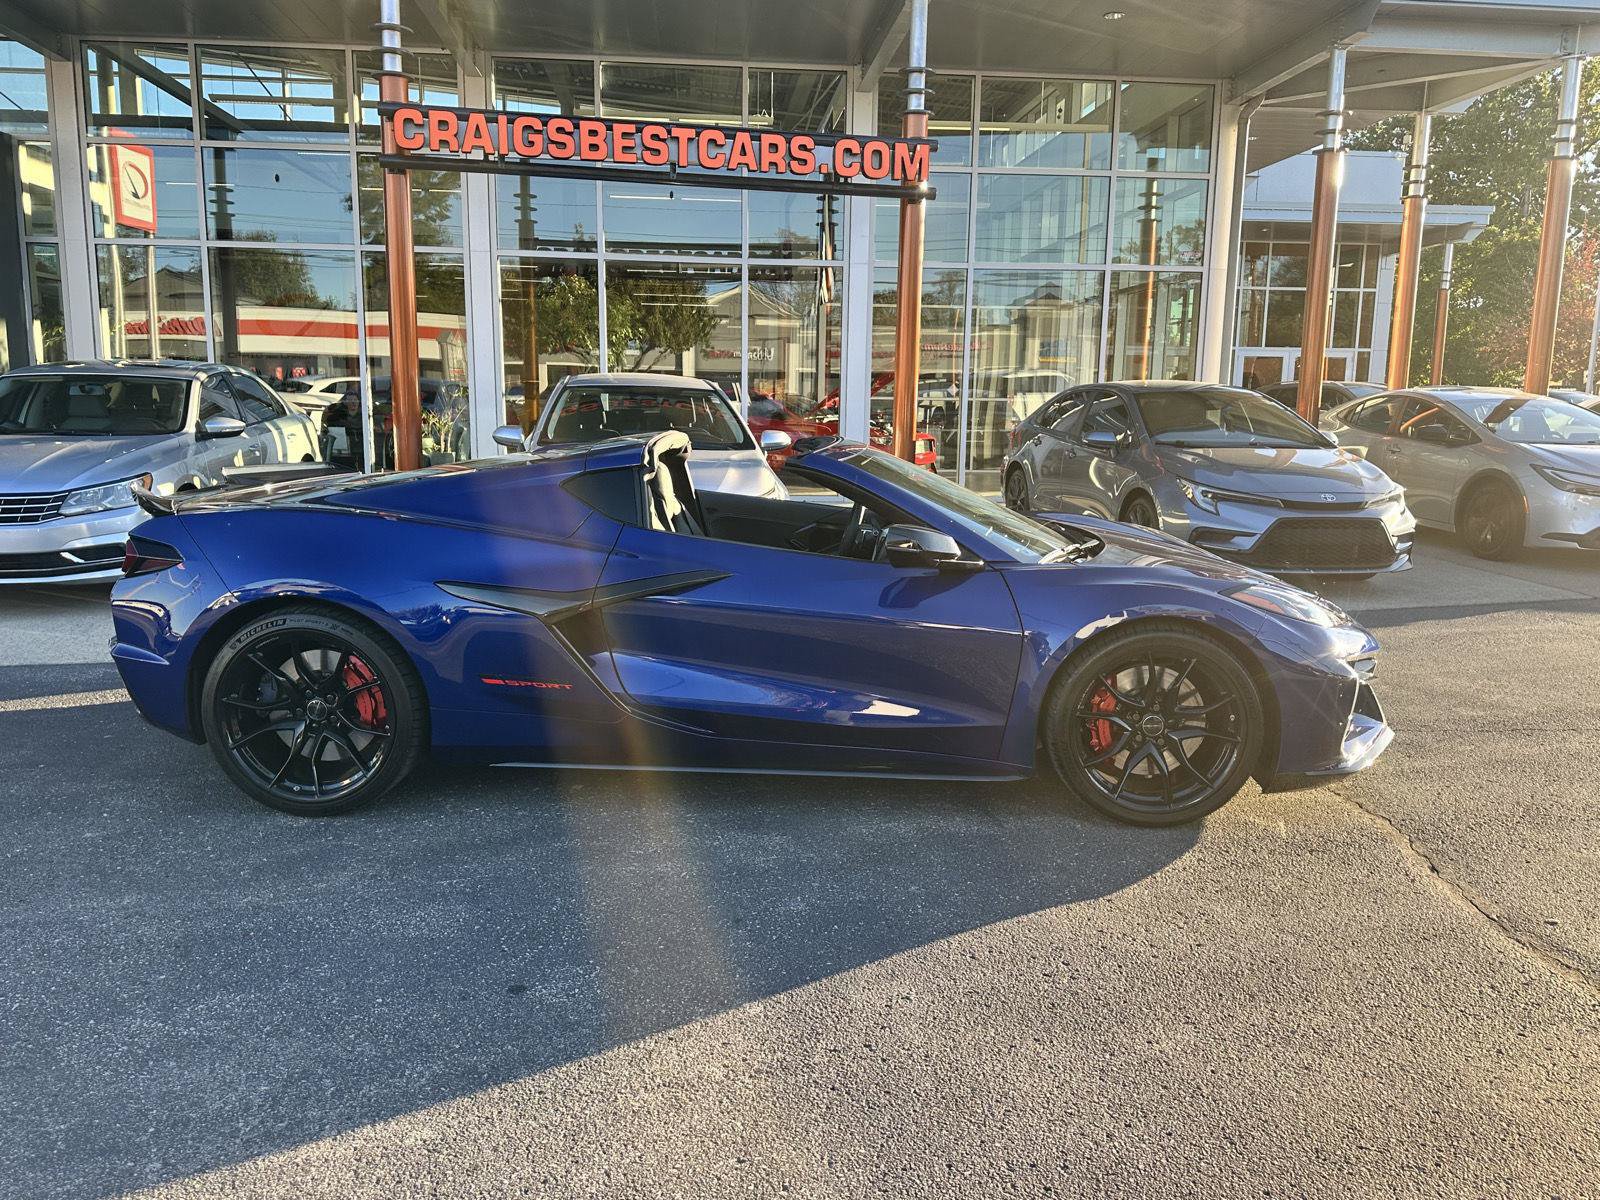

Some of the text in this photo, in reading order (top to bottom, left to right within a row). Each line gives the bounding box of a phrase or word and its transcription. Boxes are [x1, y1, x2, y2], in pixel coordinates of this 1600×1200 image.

[392, 107, 930, 182] CRAIGSBESTCARS.COM
[239, 618, 287, 642] MICHELIN
[505, 680, 573, 689] SPORT
